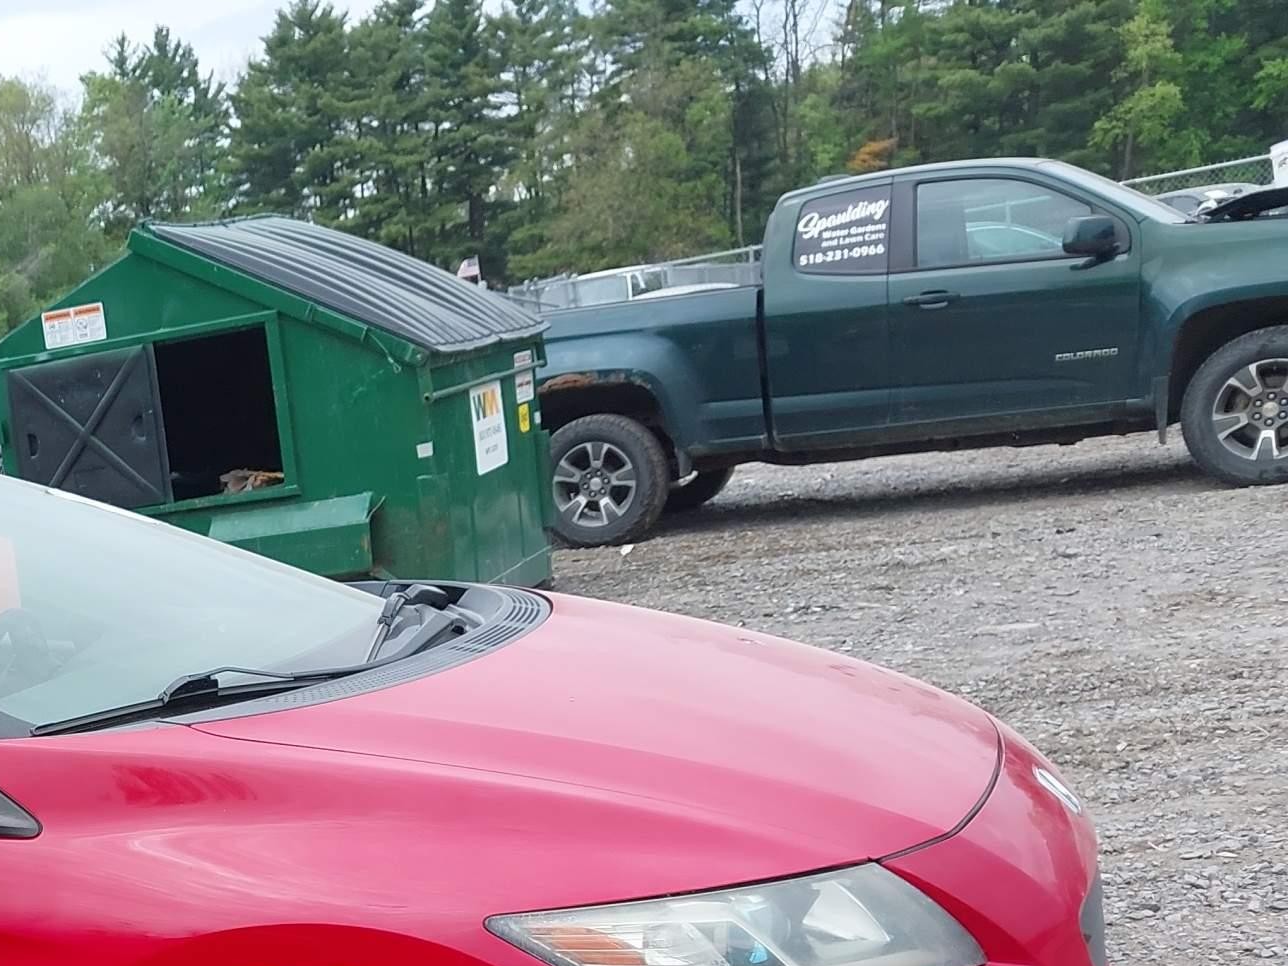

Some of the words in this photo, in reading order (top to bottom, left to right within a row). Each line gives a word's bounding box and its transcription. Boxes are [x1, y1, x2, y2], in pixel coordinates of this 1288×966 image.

[797, 199, 889, 239] Spaulding
[822, 228, 849, 239] Water
[850, 223, 886, 235] Gardens
[821, 238, 838, 248] and
[839, 235, 864, 245] Lawn
[864, 232, 885, 242] Care
[799, 244, 885, 266] 518-231-0966
[1055, 347, 1119, 361] COLORADO
